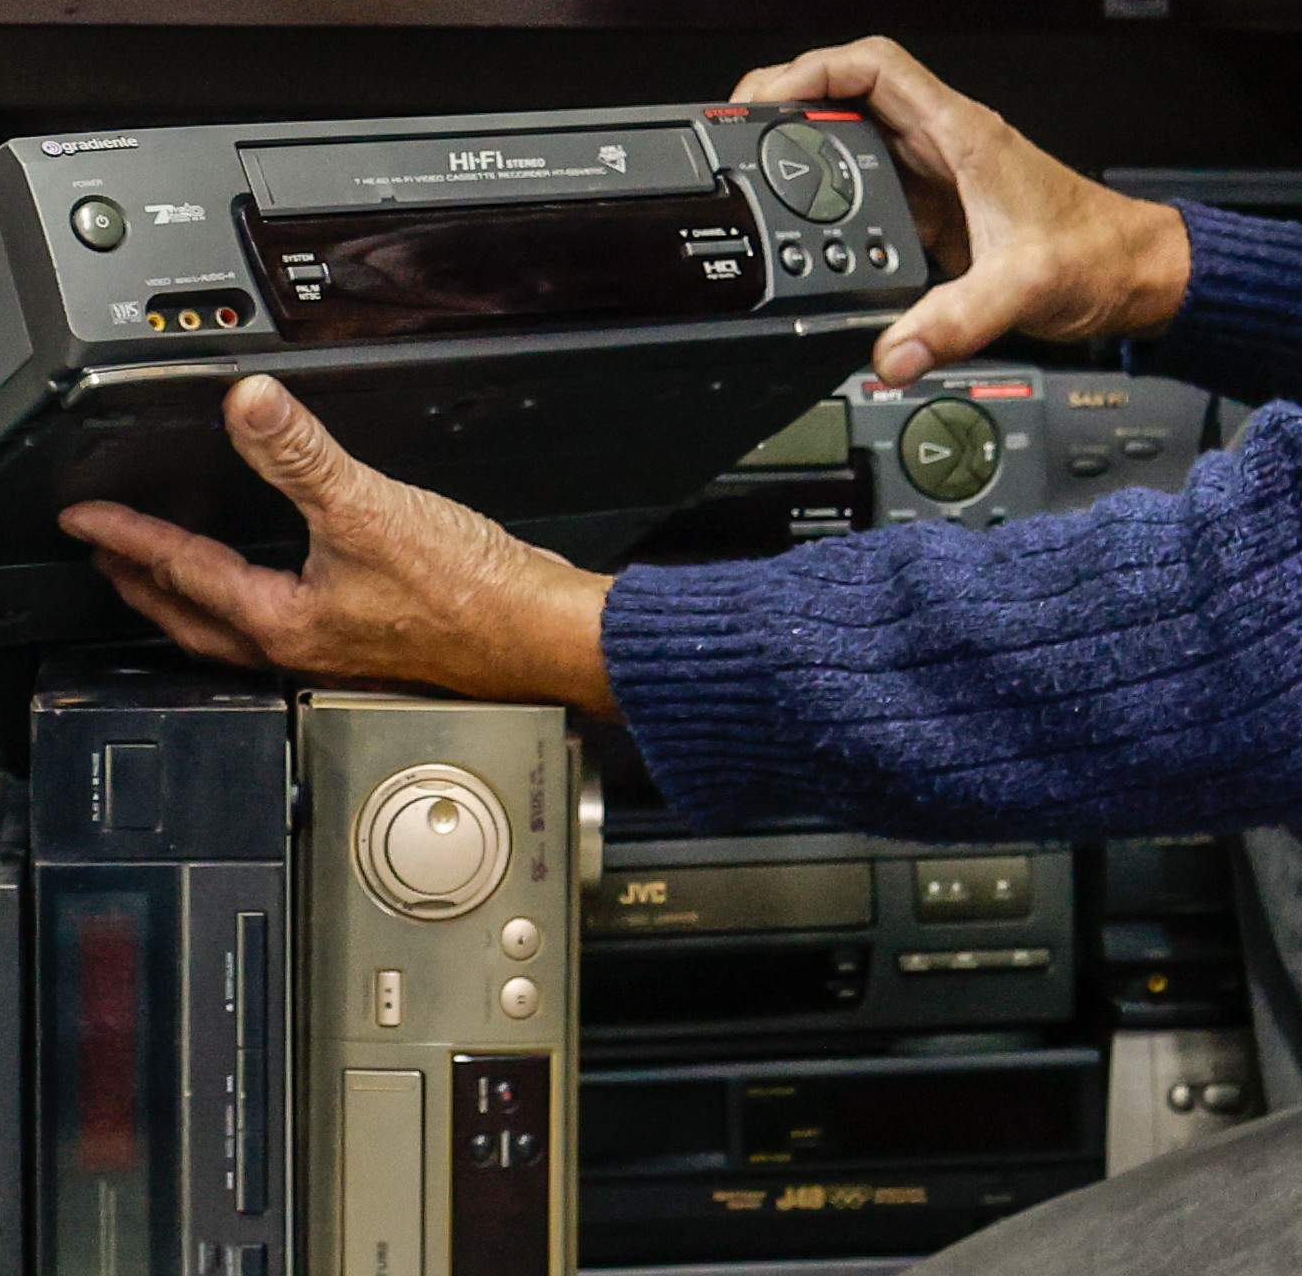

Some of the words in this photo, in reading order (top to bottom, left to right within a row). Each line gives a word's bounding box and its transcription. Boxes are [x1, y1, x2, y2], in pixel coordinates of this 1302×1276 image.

[61, 136, 139, 155] gradiente
[505, 157, 546, 169] STEREO
[415, 174, 444, 184] VIDEO
[446, 172, 496, 183] CASSETTE
[618, 882, 666, 905] JVC
